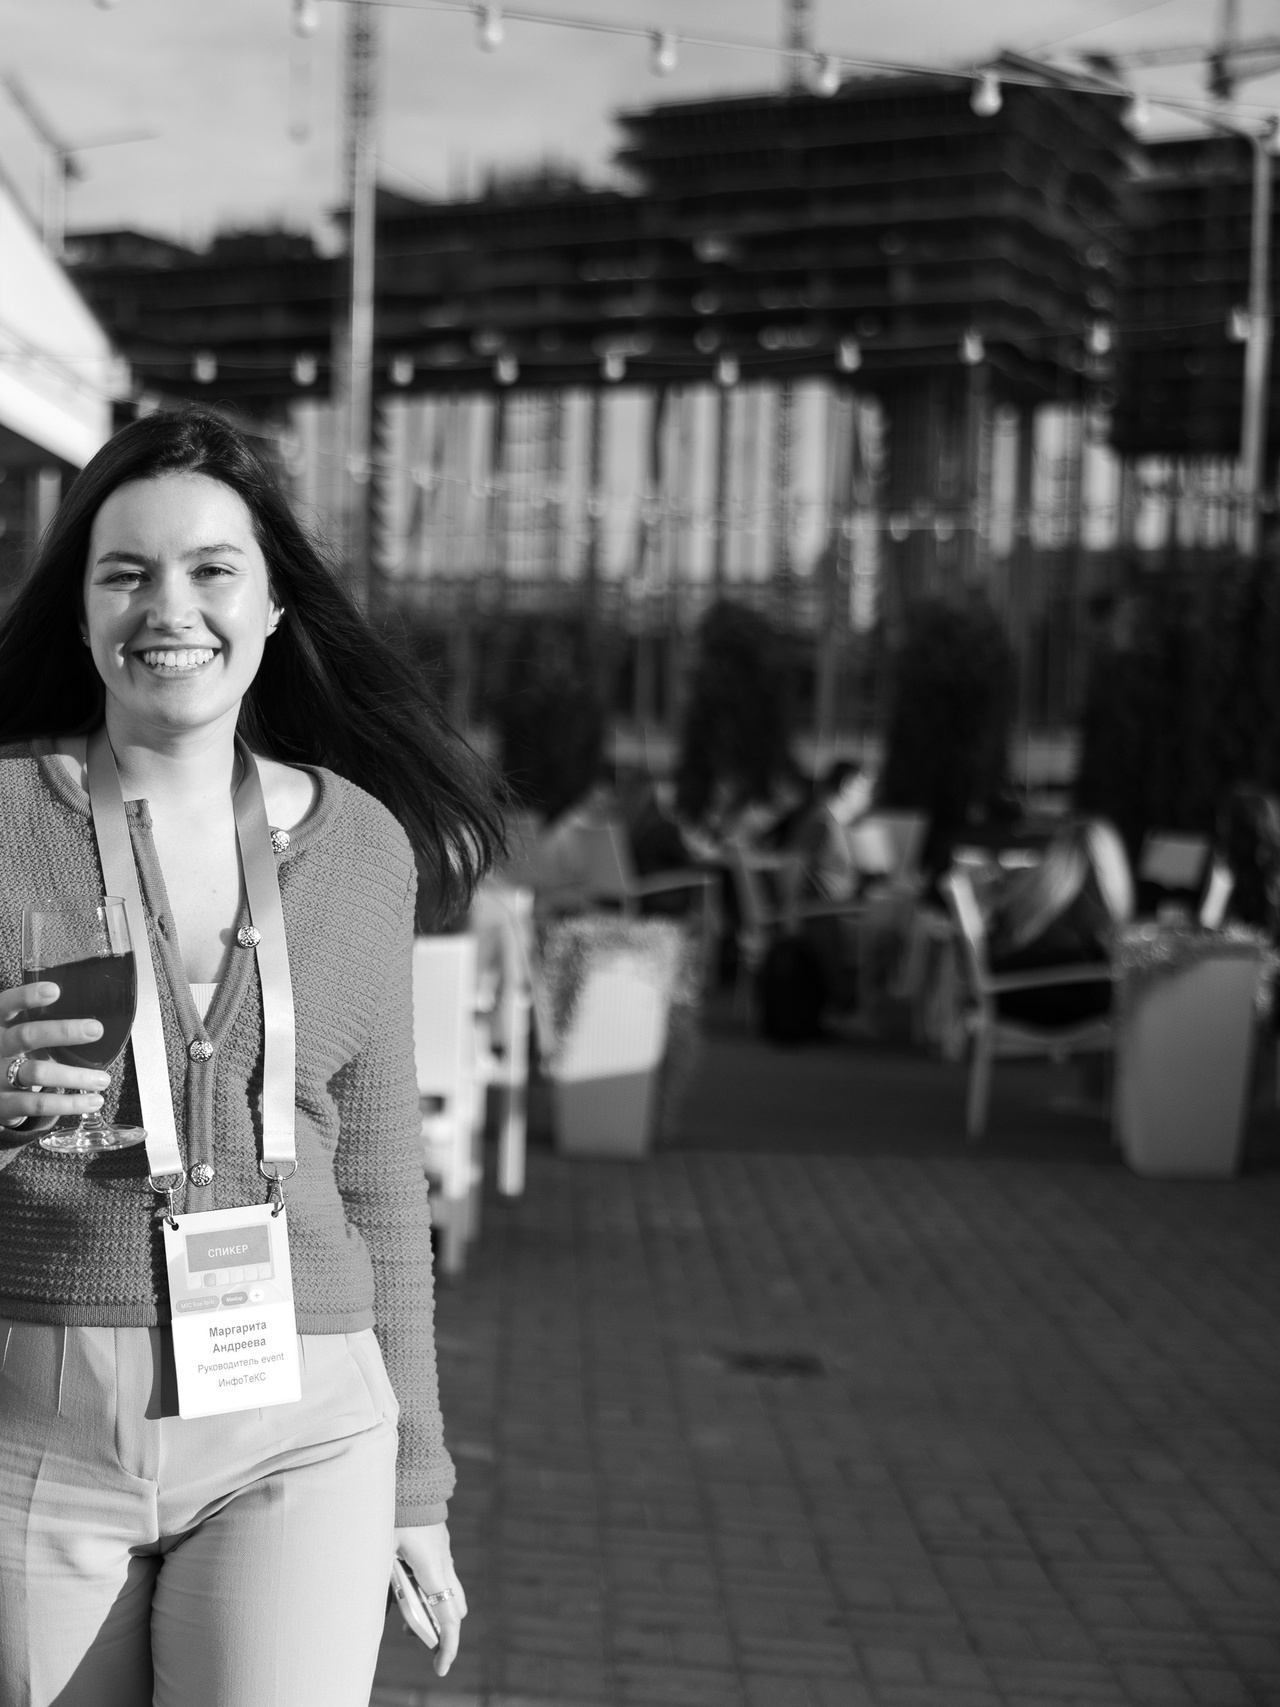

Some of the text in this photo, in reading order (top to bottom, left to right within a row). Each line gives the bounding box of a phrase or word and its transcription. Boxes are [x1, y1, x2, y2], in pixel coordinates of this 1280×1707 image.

[208, 1245, 248, 1258] СПИКЕР
[209, 1322, 267, 1338] Маргарита
[213, 1338, 266, 1353] Андреева
[198, 1353, 284, 1373] Руководитель event
[219, 1372, 267, 1387] ИнфоТеКС
